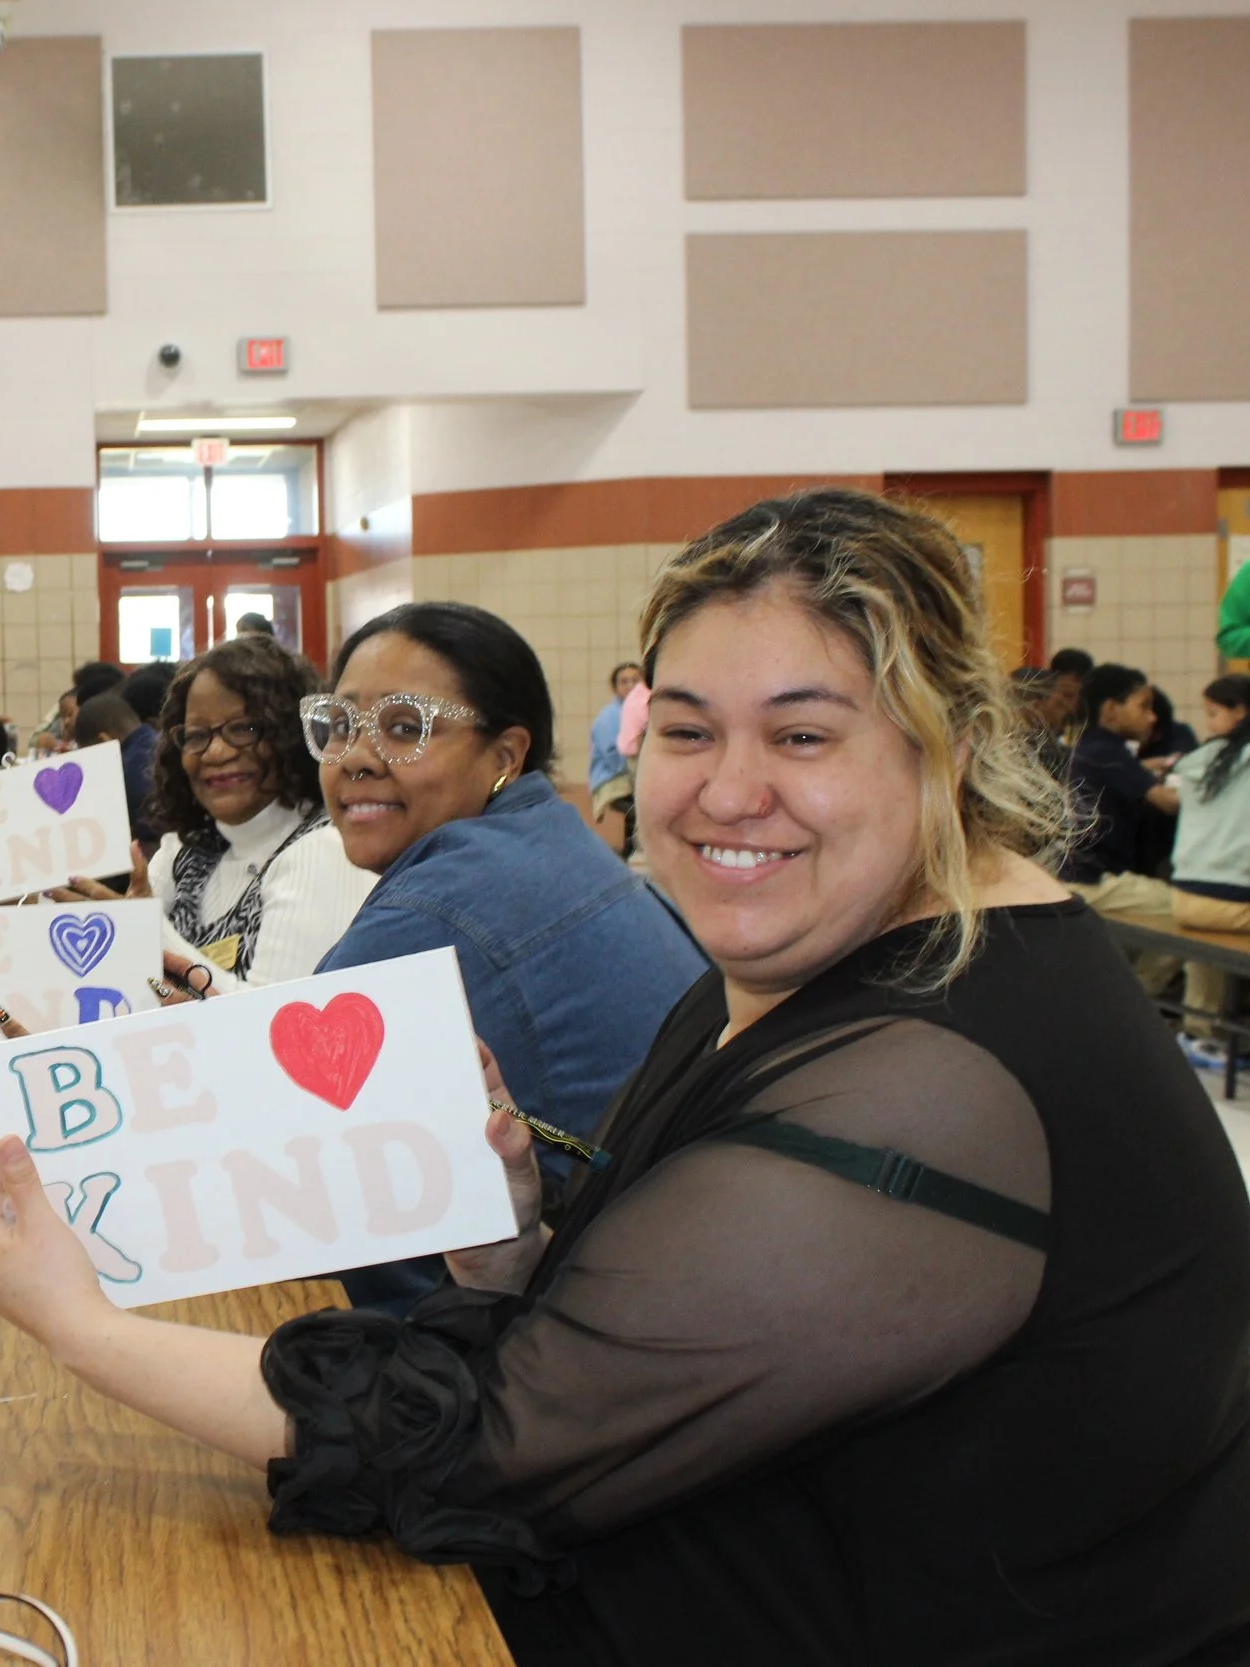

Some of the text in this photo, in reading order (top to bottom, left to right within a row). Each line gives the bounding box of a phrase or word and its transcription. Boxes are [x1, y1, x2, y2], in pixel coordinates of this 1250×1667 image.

[247, 338, 284, 369] EXIT
[8, 1023, 217, 1153] BE
[42, 1120, 453, 1284] KIND
